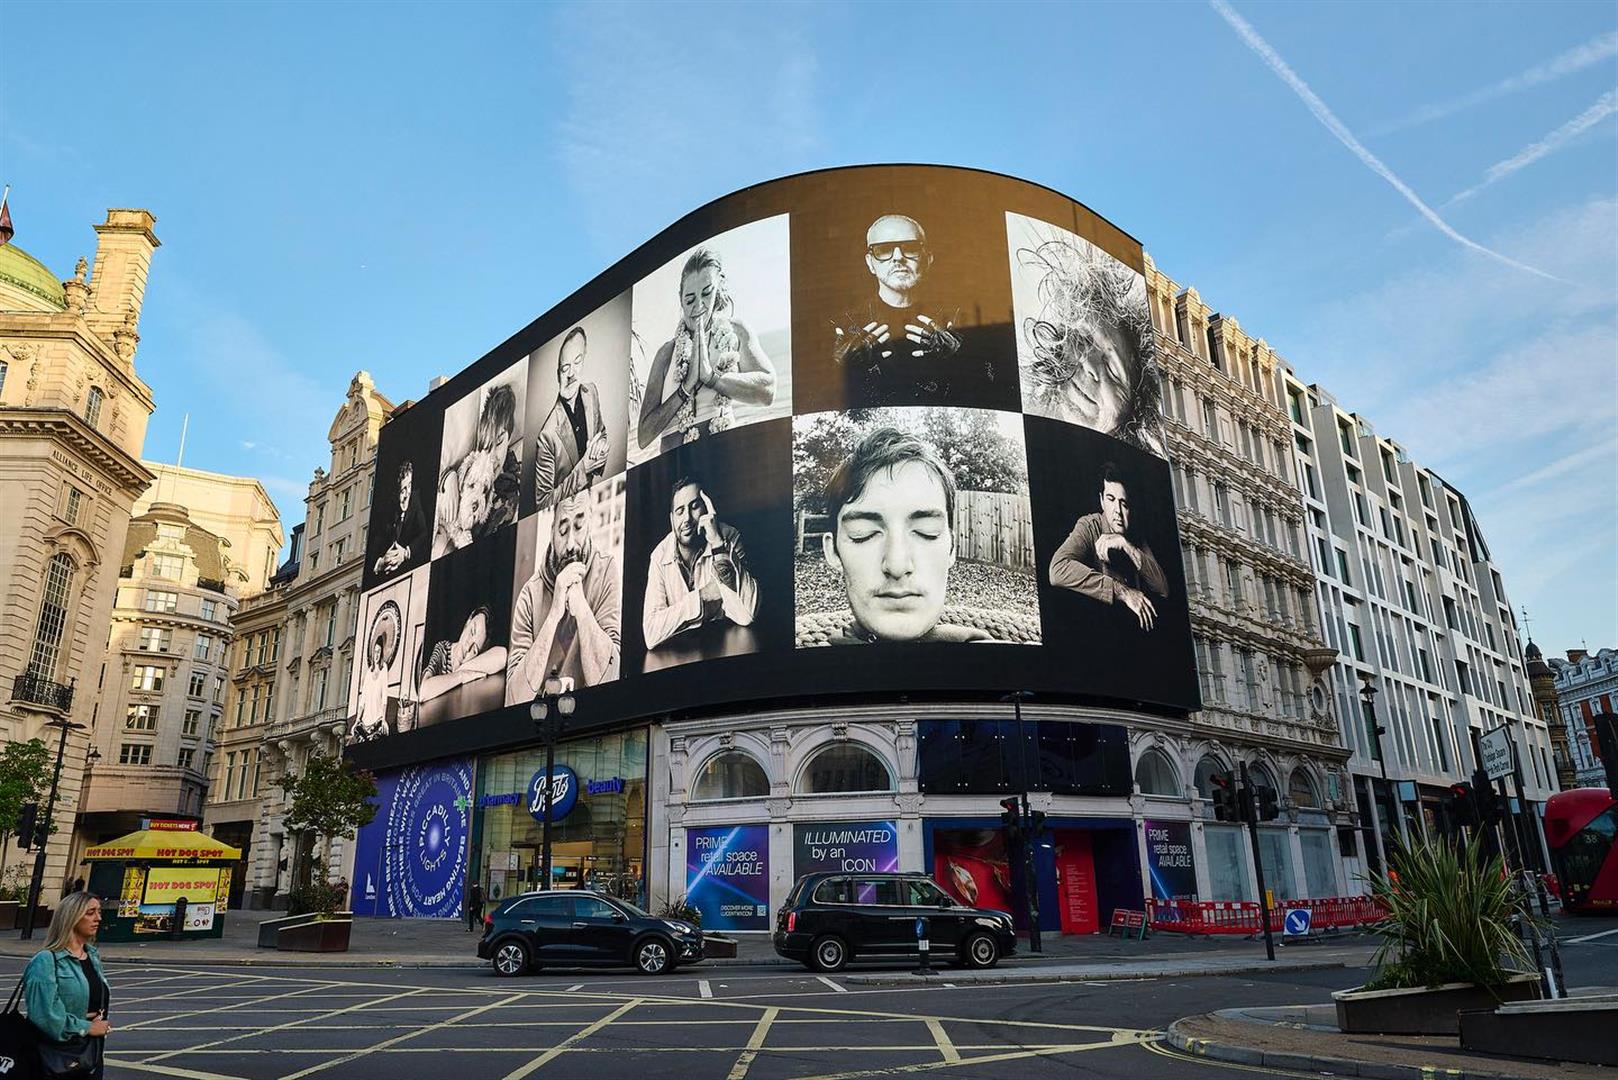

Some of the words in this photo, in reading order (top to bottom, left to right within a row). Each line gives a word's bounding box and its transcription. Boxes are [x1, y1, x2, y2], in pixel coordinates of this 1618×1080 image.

[52, 450, 78, 473] ALLIANCE
[81, 470, 93, 482] LIFE
[96, 480, 112, 497] OFFICE
[587, 776, 622, 795] beauty
[388, 783, 402, 827] HEART
[400, 800, 411, 832] WITH
[409, 776, 421, 798] YOU
[479, 793, 520, 807] pharmacy
[419, 804, 451, 847] PICCADILLY
[804, 829, 892, 845] ILLUMINATED
[1148, 828, 1169, 842] PRIME
[1585, 834, 1598, 843] 38
[695, 836, 728, 849] PRIME
[1153, 842, 1168, 854] retail
[1168, 844, 1187, 855] space
[86, 849, 100, 857] HOT
[101, 849, 117, 857] DOG
[117, 848, 135, 856] SPOT
[178, 849, 198, 857] DOG
[701, 850, 724, 862] retail
[726, 851, 758, 863] space
[812, 846, 827, 861] by
[829, 848, 846, 858] an
[419, 848, 447, 872] LIGHTS
[445, 835, 466, 891] BEATING
[841, 858, 876, 872] ICON
[1158, 855, 1191, 867] AVAILABLE
[705, 861, 764, 876] AVAILABLE
[149, 881, 170, 890] HOT
[171, 881, 192, 889] DOG
[193, 881, 217, 889] SPOT
[423, 887, 446, 906] HEART
